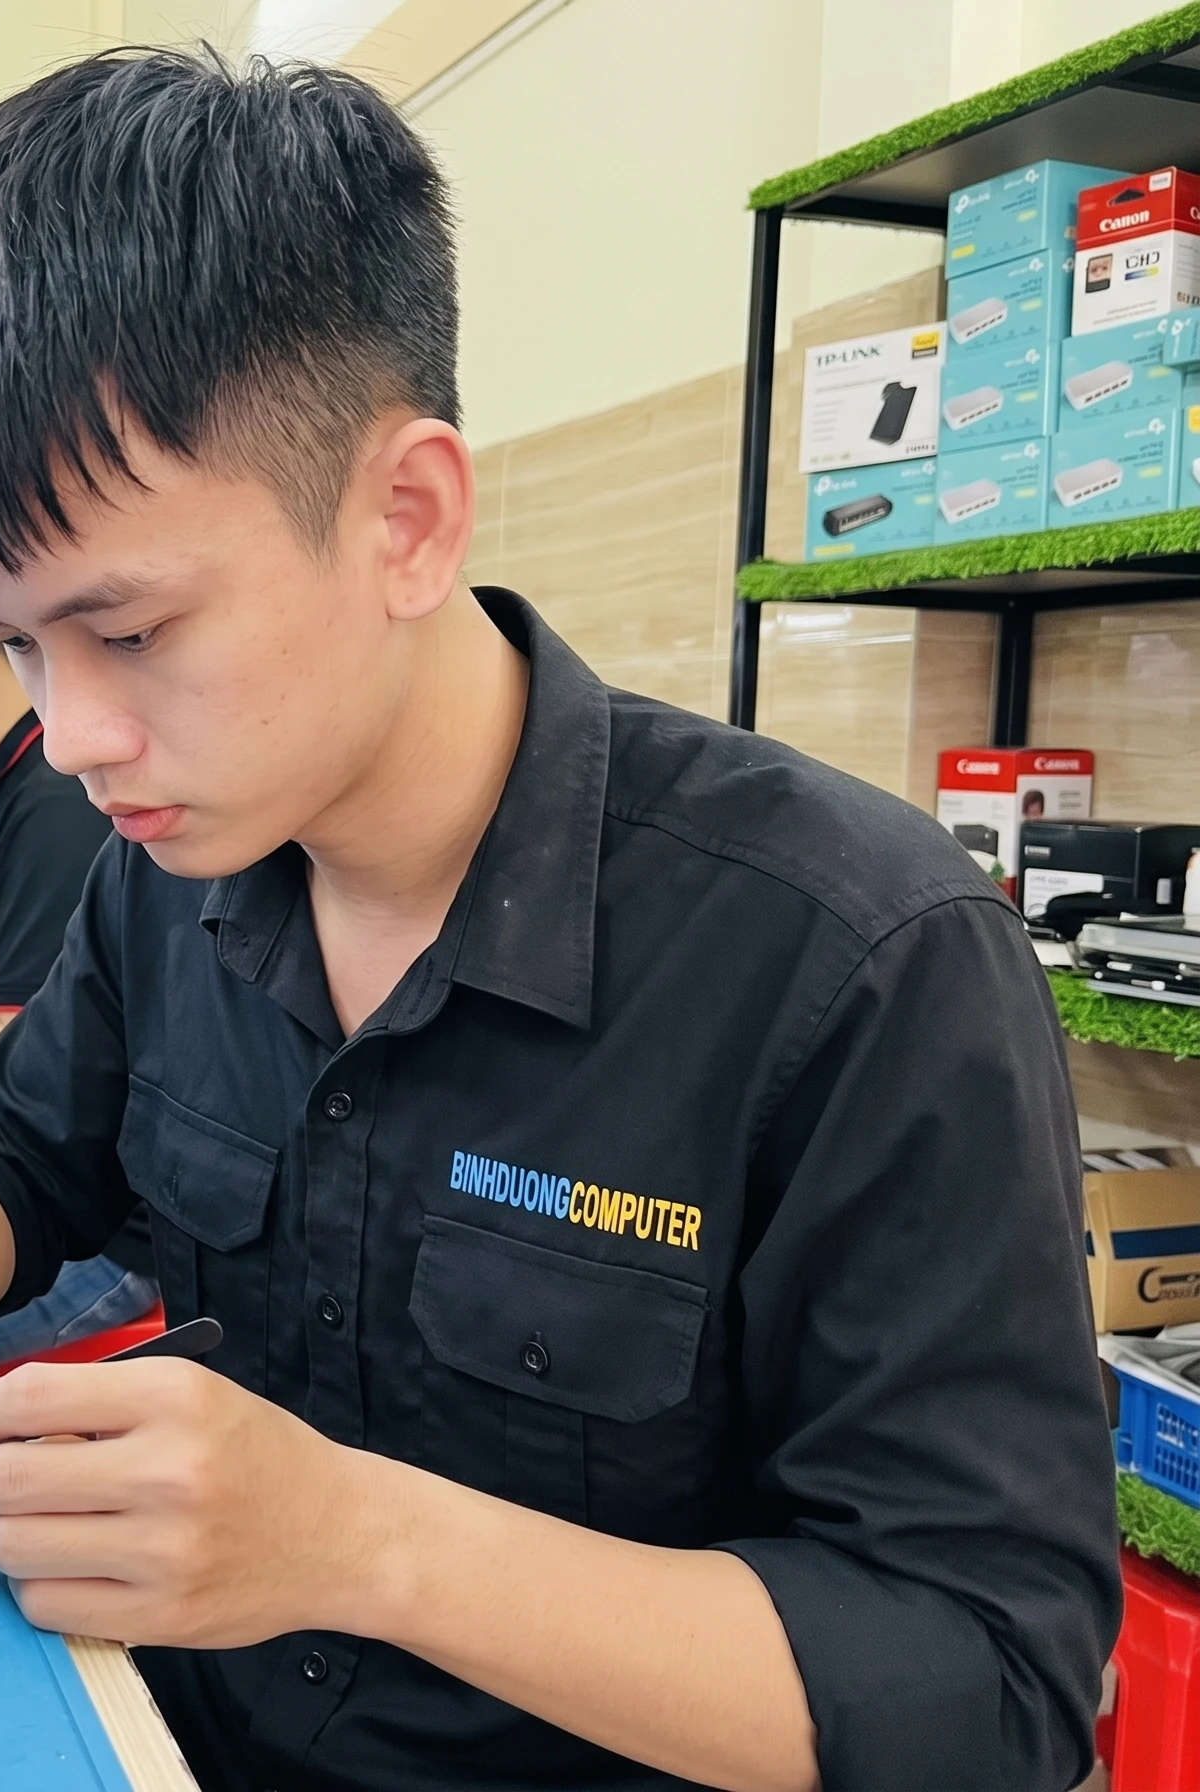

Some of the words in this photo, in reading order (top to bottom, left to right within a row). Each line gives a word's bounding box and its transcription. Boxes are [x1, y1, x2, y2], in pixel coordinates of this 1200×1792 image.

[1099, 209, 1150, 233] Canon
[814, 346, 882, 369] TP-LINK
[450, 1150, 702, 1250] BINHDUONGCOMPUTER
